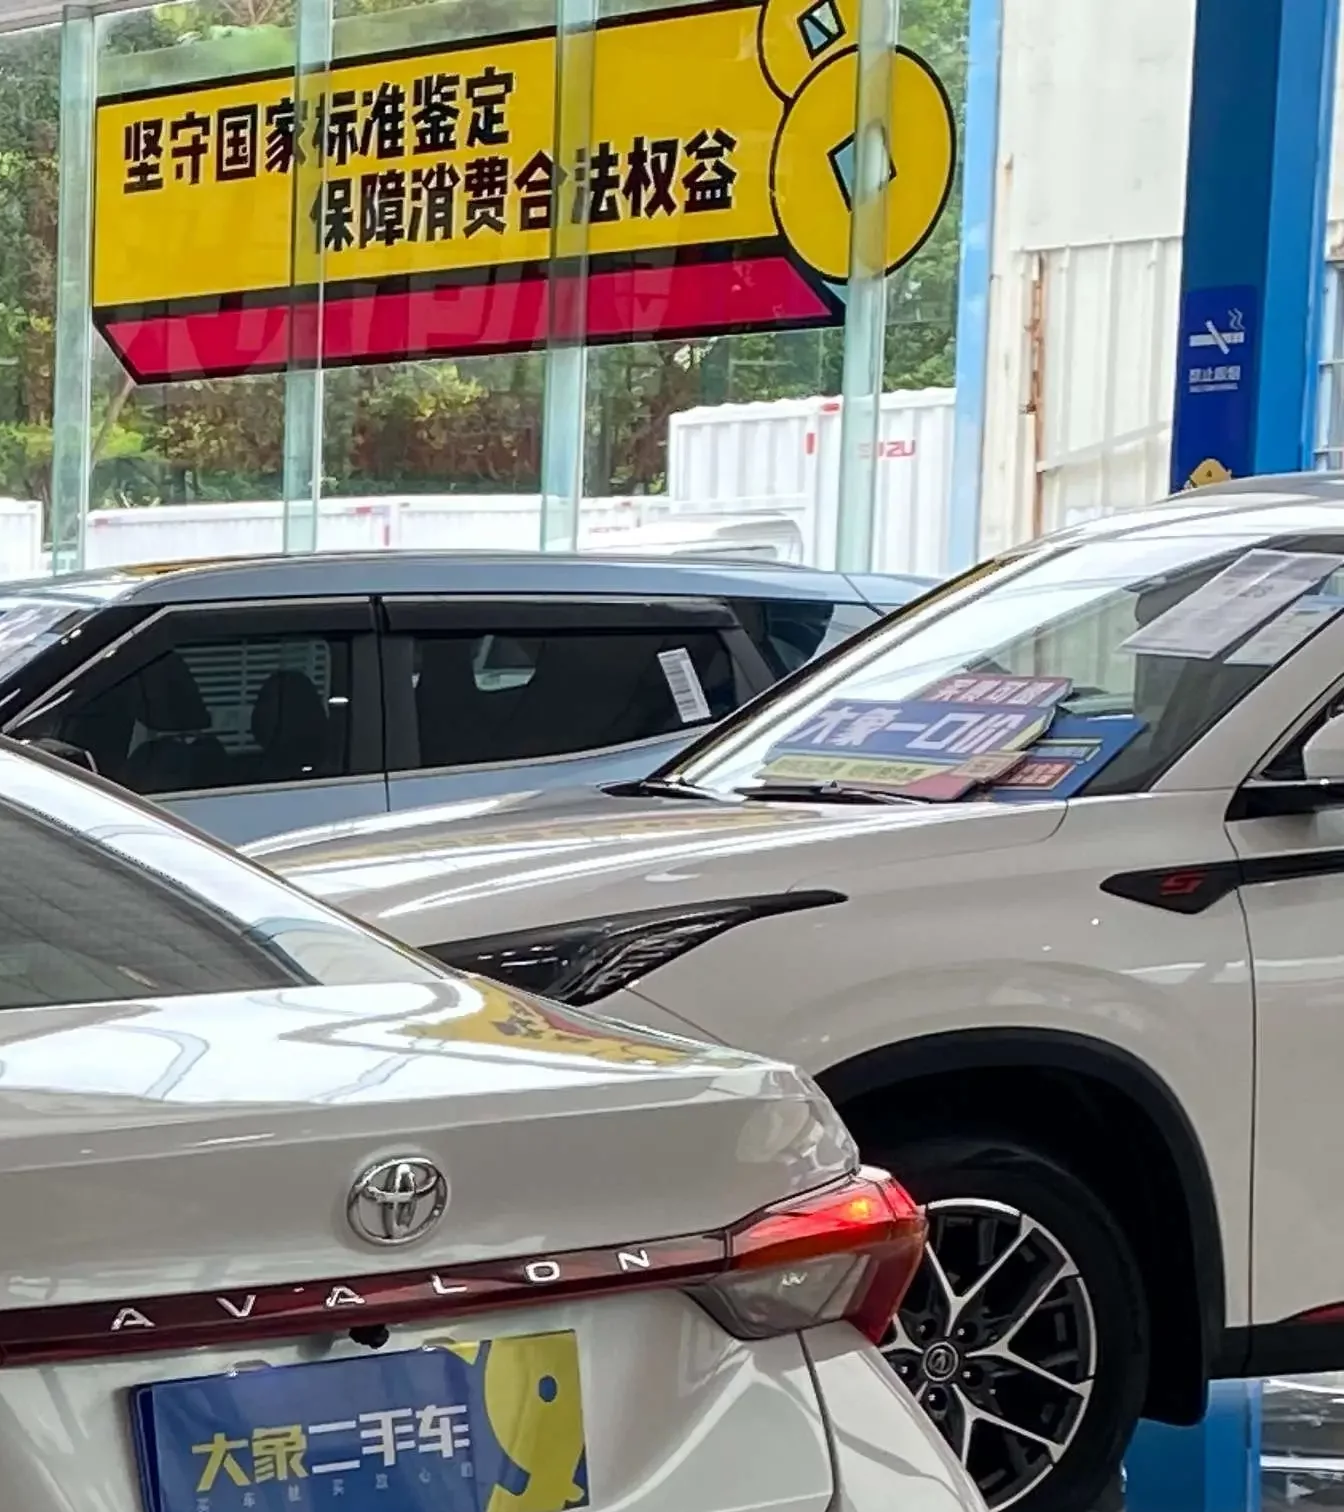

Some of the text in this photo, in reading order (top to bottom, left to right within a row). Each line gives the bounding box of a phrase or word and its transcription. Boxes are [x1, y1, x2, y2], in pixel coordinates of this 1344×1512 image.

[123, 67, 516, 195] 坚守国家标准鉴定
[311, 129, 738, 253] 保障消费合法权益
[109, 1246, 652, 1334] AVALON
[191, 1403, 471, 1493] 大象二手车
